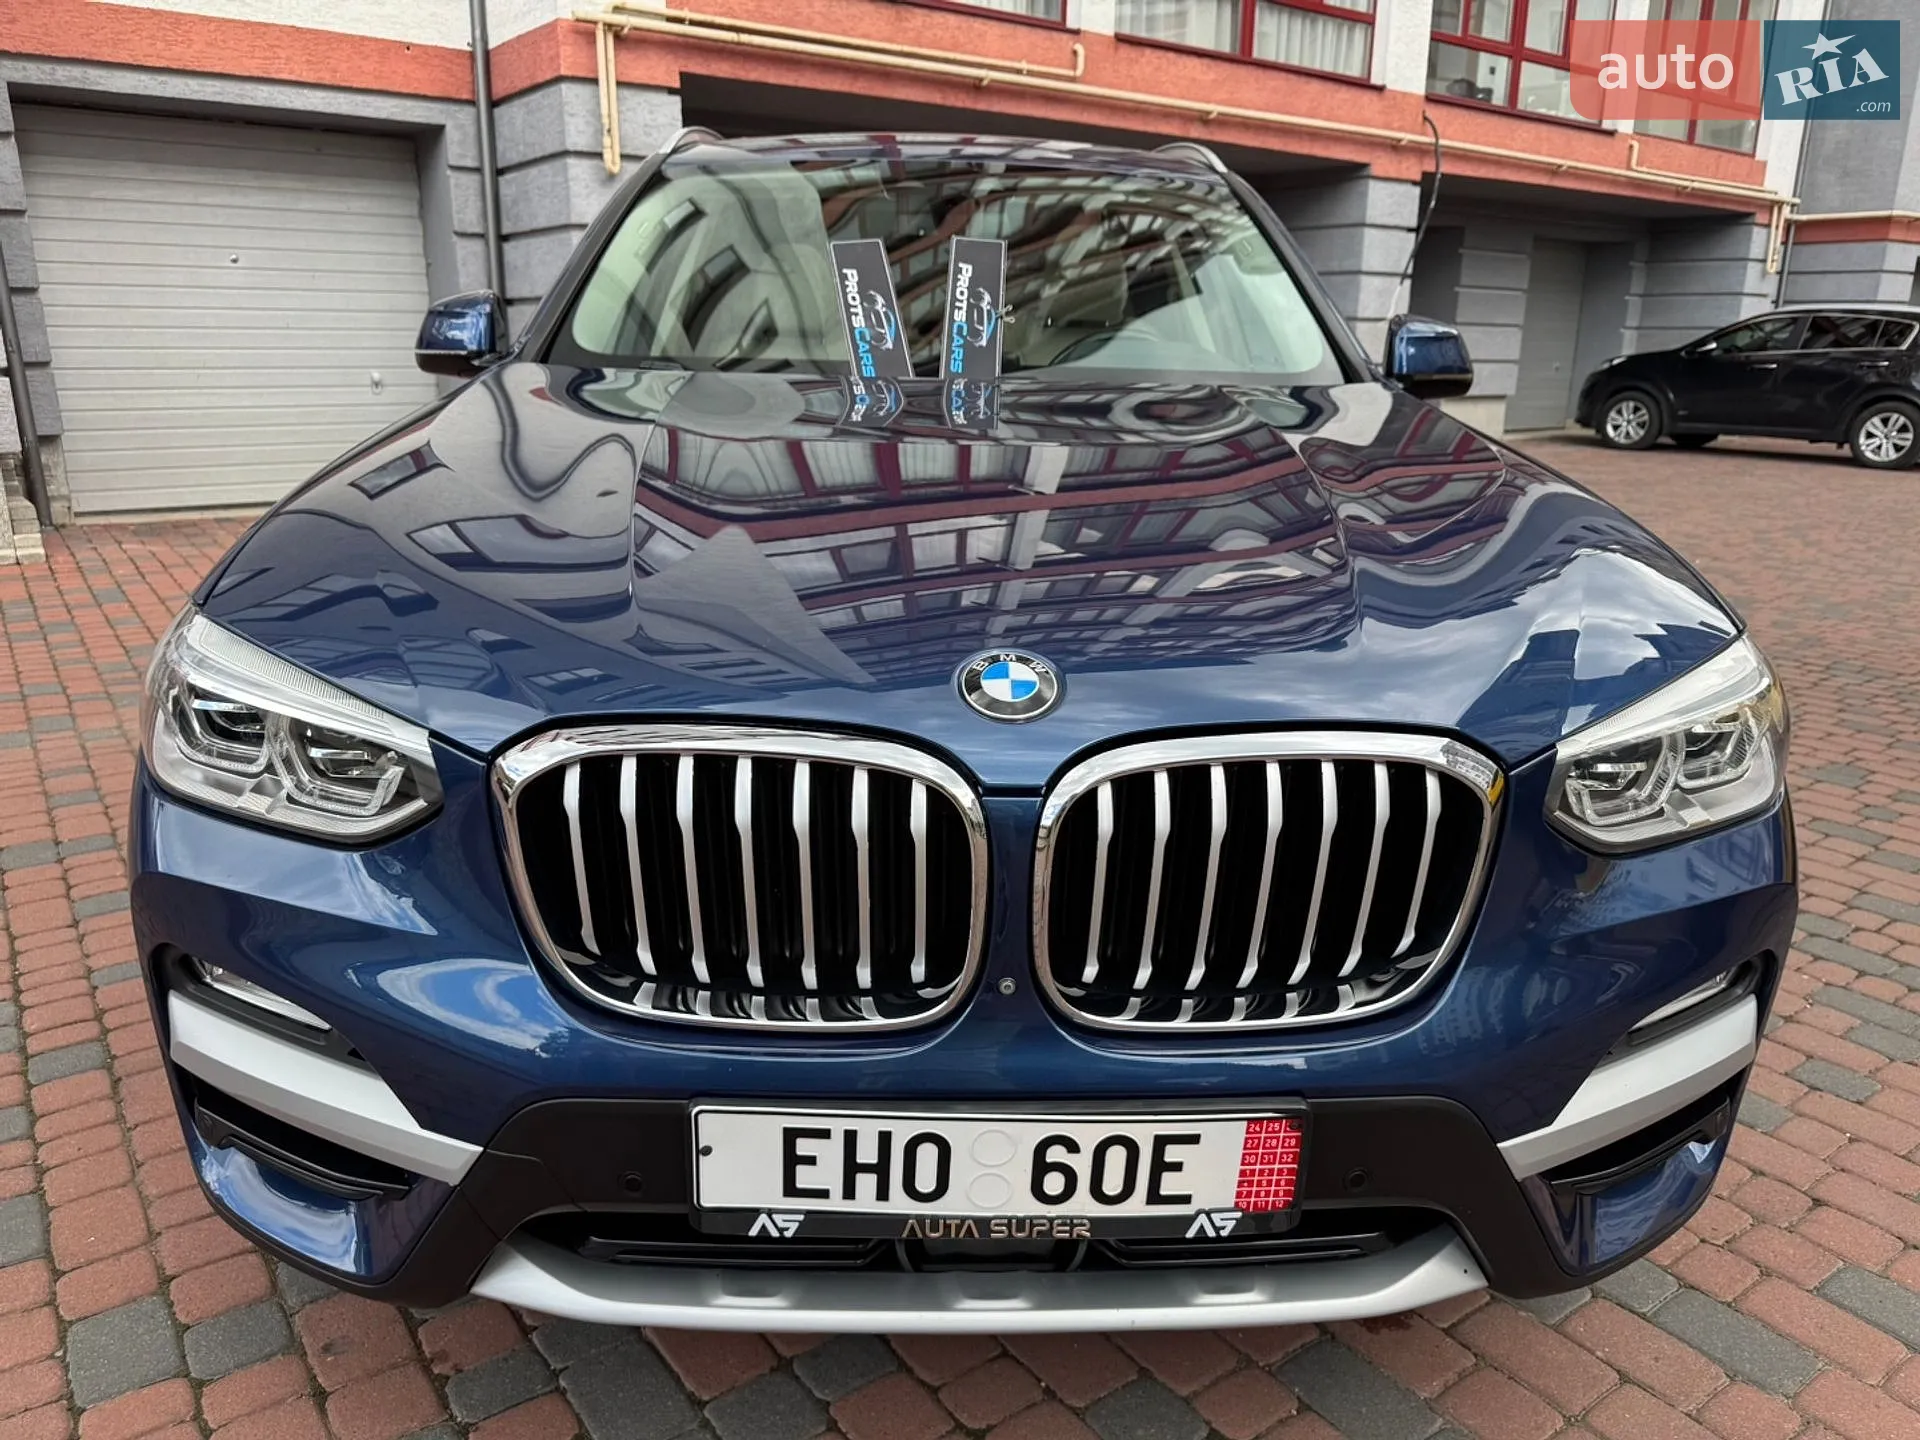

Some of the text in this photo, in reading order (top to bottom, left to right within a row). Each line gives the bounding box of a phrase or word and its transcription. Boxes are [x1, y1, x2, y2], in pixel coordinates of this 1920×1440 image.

[973, 654, 1049, 673] BMW
[1248, 1124, 1260, 1132] 24
[1267, 1123, 1280, 1132] 25
[1246, 1138, 1296, 1148] 27 28 29
[1244, 1154, 1293, 1163] 30 31 32
[901, 1218, 1092, 1238] AUTA SUPER
